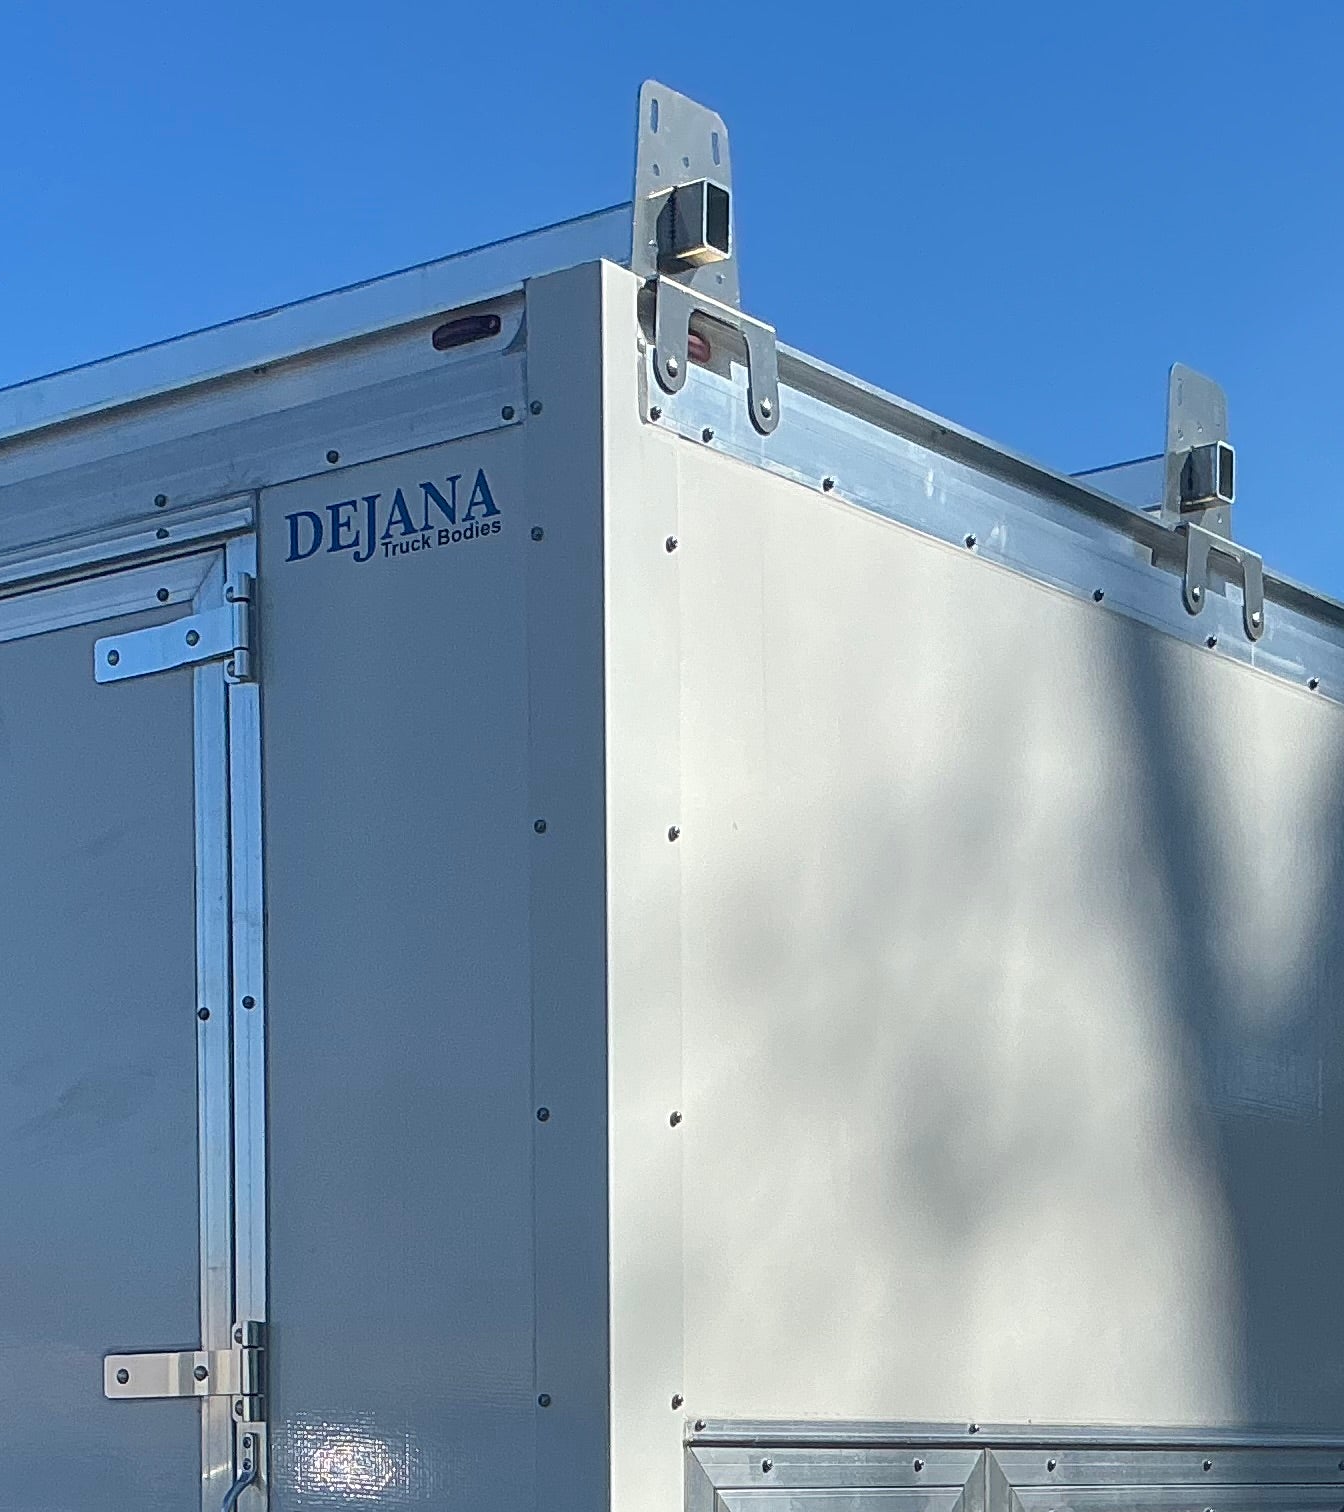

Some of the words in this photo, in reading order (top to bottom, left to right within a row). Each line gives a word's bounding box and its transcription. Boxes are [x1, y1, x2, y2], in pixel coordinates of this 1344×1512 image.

[284, 467, 502, 563] DEJANA
[380, 532, 433, 558] Truck
[437, 518, 503, 547] Bodies
